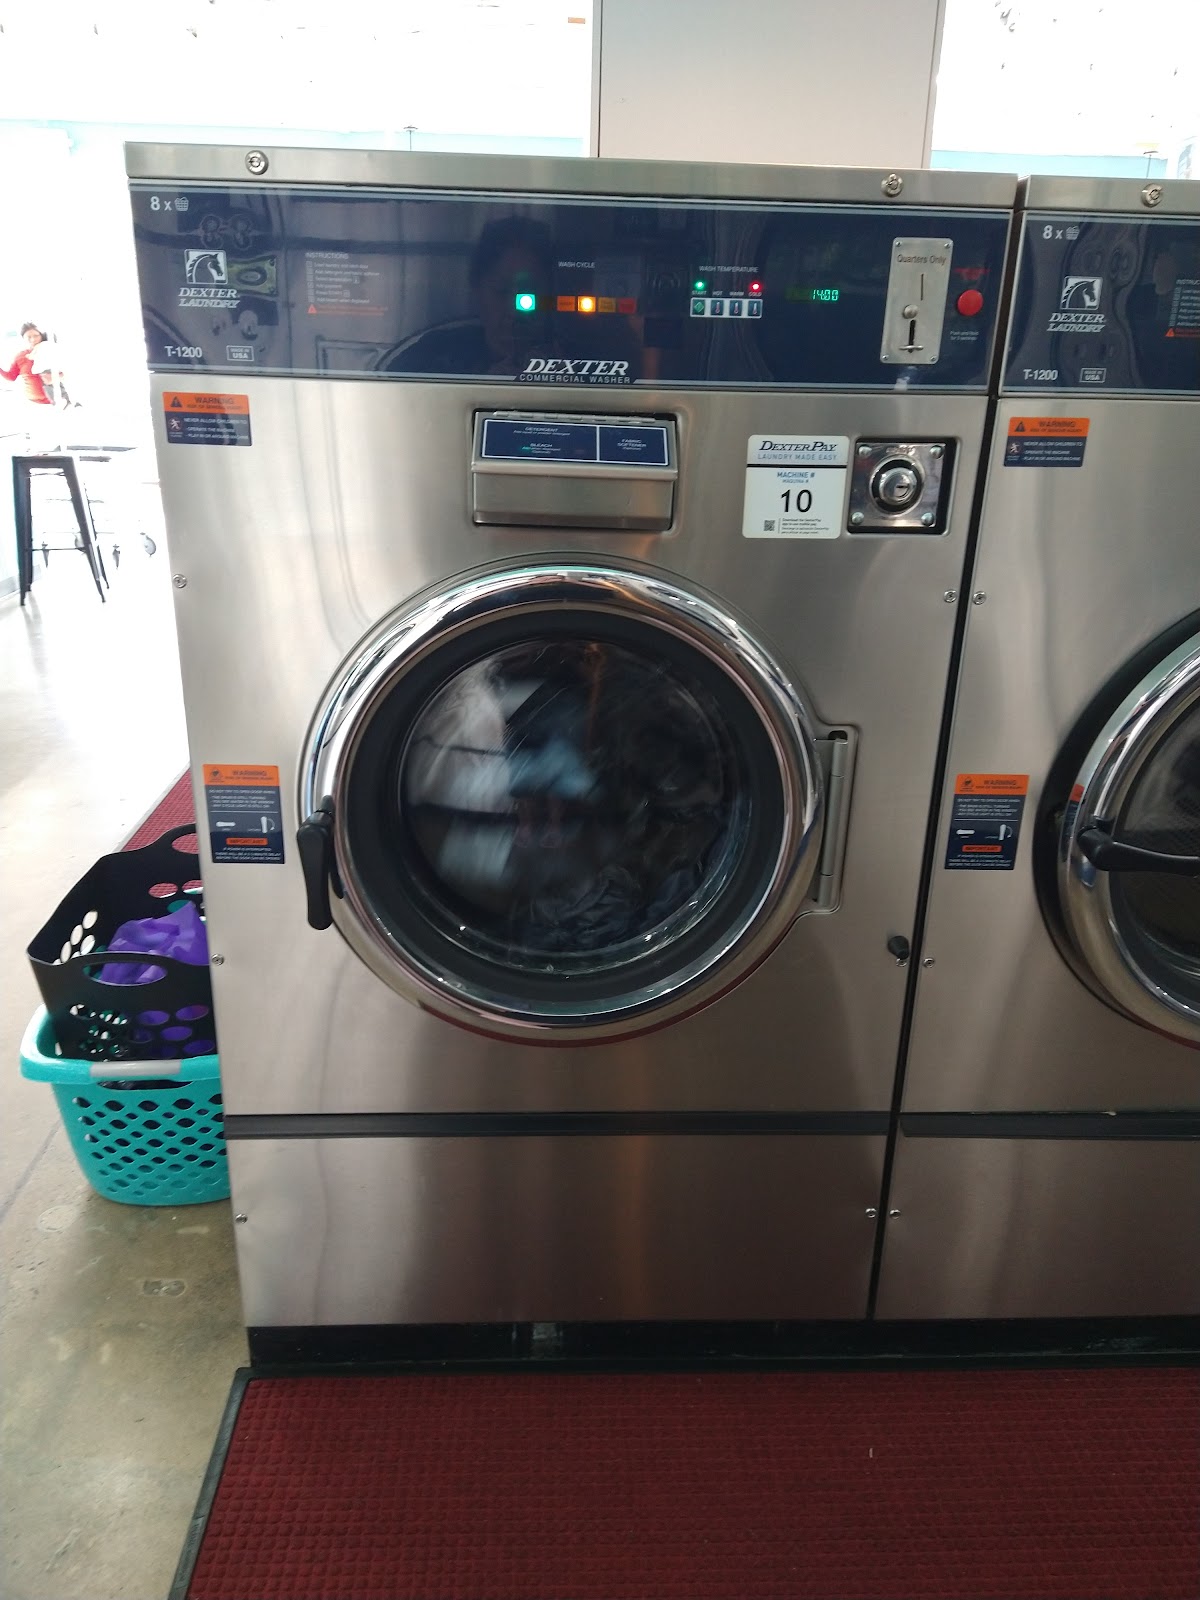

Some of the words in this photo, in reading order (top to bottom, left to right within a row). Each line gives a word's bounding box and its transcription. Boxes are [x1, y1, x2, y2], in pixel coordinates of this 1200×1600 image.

[150, 196, 161, 211] 8
[163, 200, 172, 211] x
[1042, 225, 1053, 240] 8
[1055, 230, 1063, 240] x
[896, 254, 928, 264] Quarters
[929, 255, 946, 266] Only
[178, 287, 238, 298] DEXTER
[178, 298, 240, 308] LAUNDRY
[1048, 313, 1105, 323] DEXTER
[1046, 323, 1106, 333] LAUNDRY
[164, 346, 203, 358] T-1200
[523, 358, 629, 376] DEXTER
[520, 374, 585, 383] COMMERCIAL
[589, 376, 630, 384] WASHER
[1023, 369, 1059, 381] T-1200
[195, 396, 234, 404] WARNING
[781, 489, 813, 513] 10
